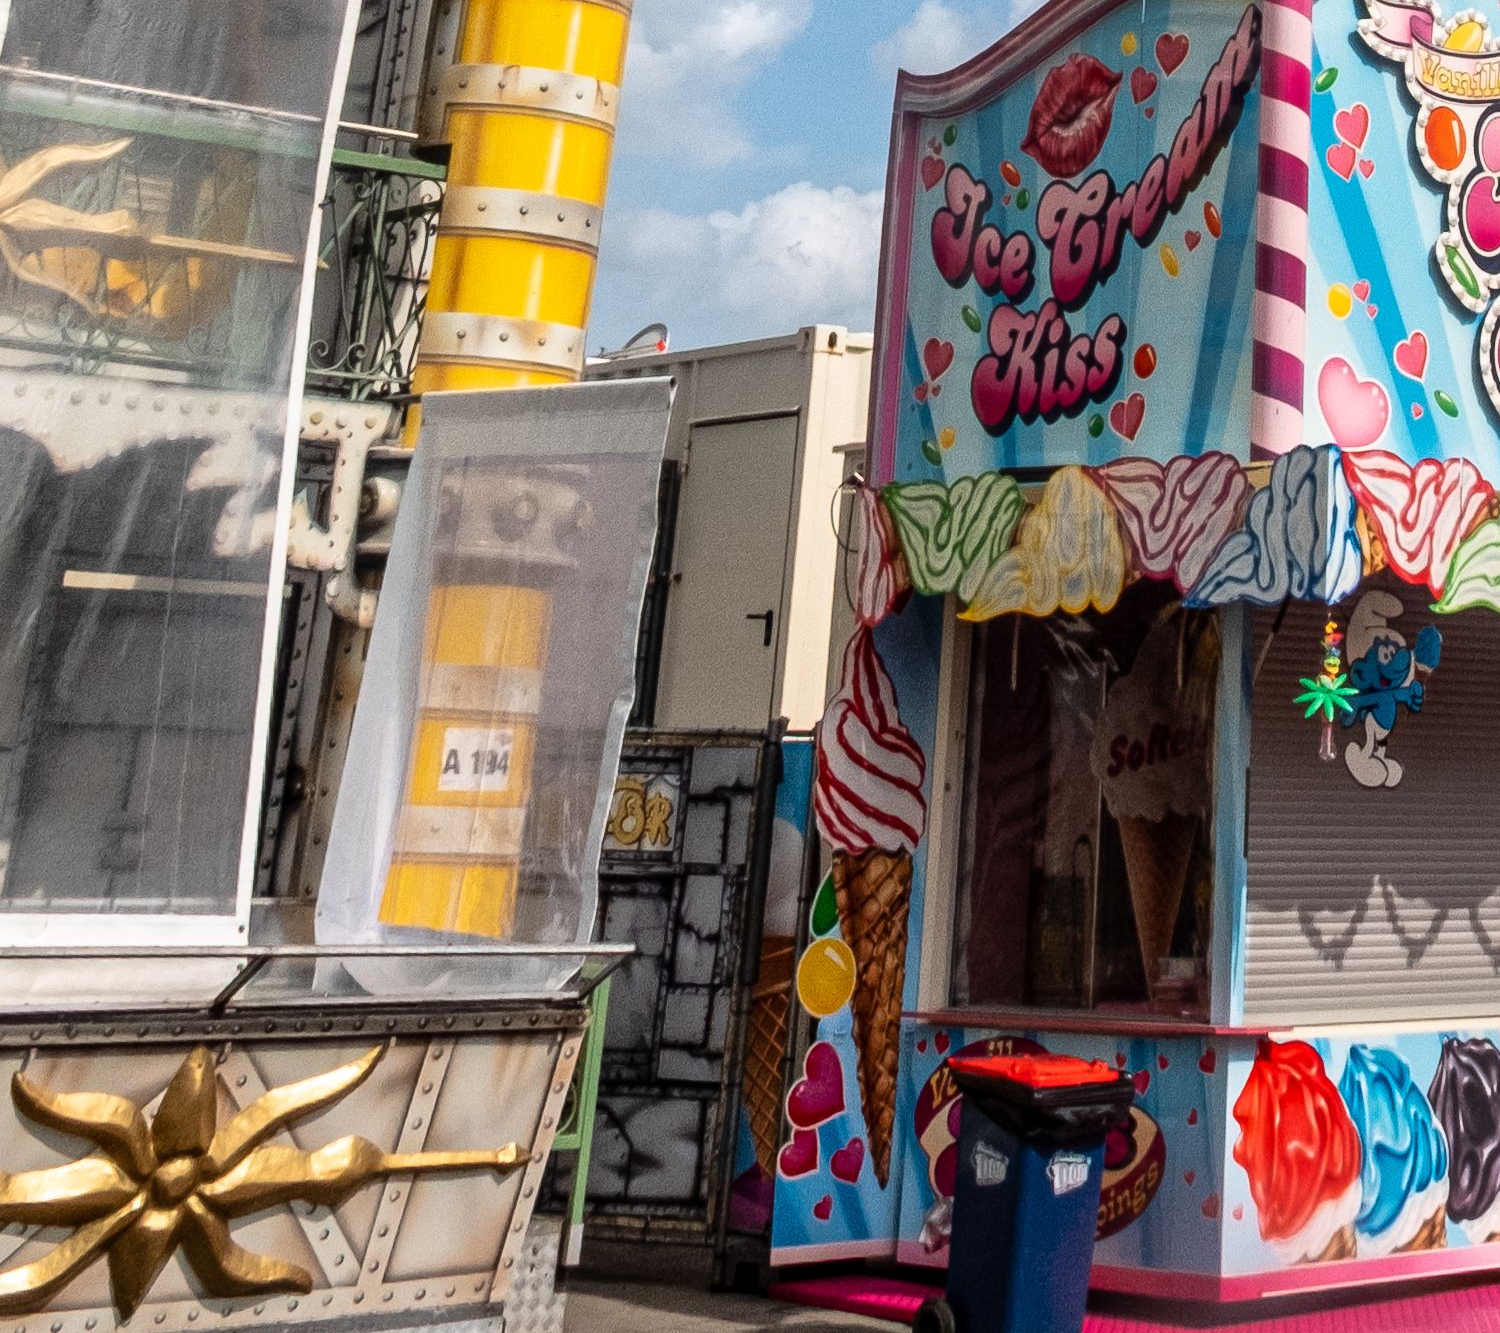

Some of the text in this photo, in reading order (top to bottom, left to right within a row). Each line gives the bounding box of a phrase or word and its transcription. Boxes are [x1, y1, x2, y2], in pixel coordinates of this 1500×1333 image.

[931, 5, 1262, 310] Ice Cream
[971, 298, 1127, 436] Kiss
[442, 747, 510, 776] A 194
[1096, 1159, 1159, 1228] pings
